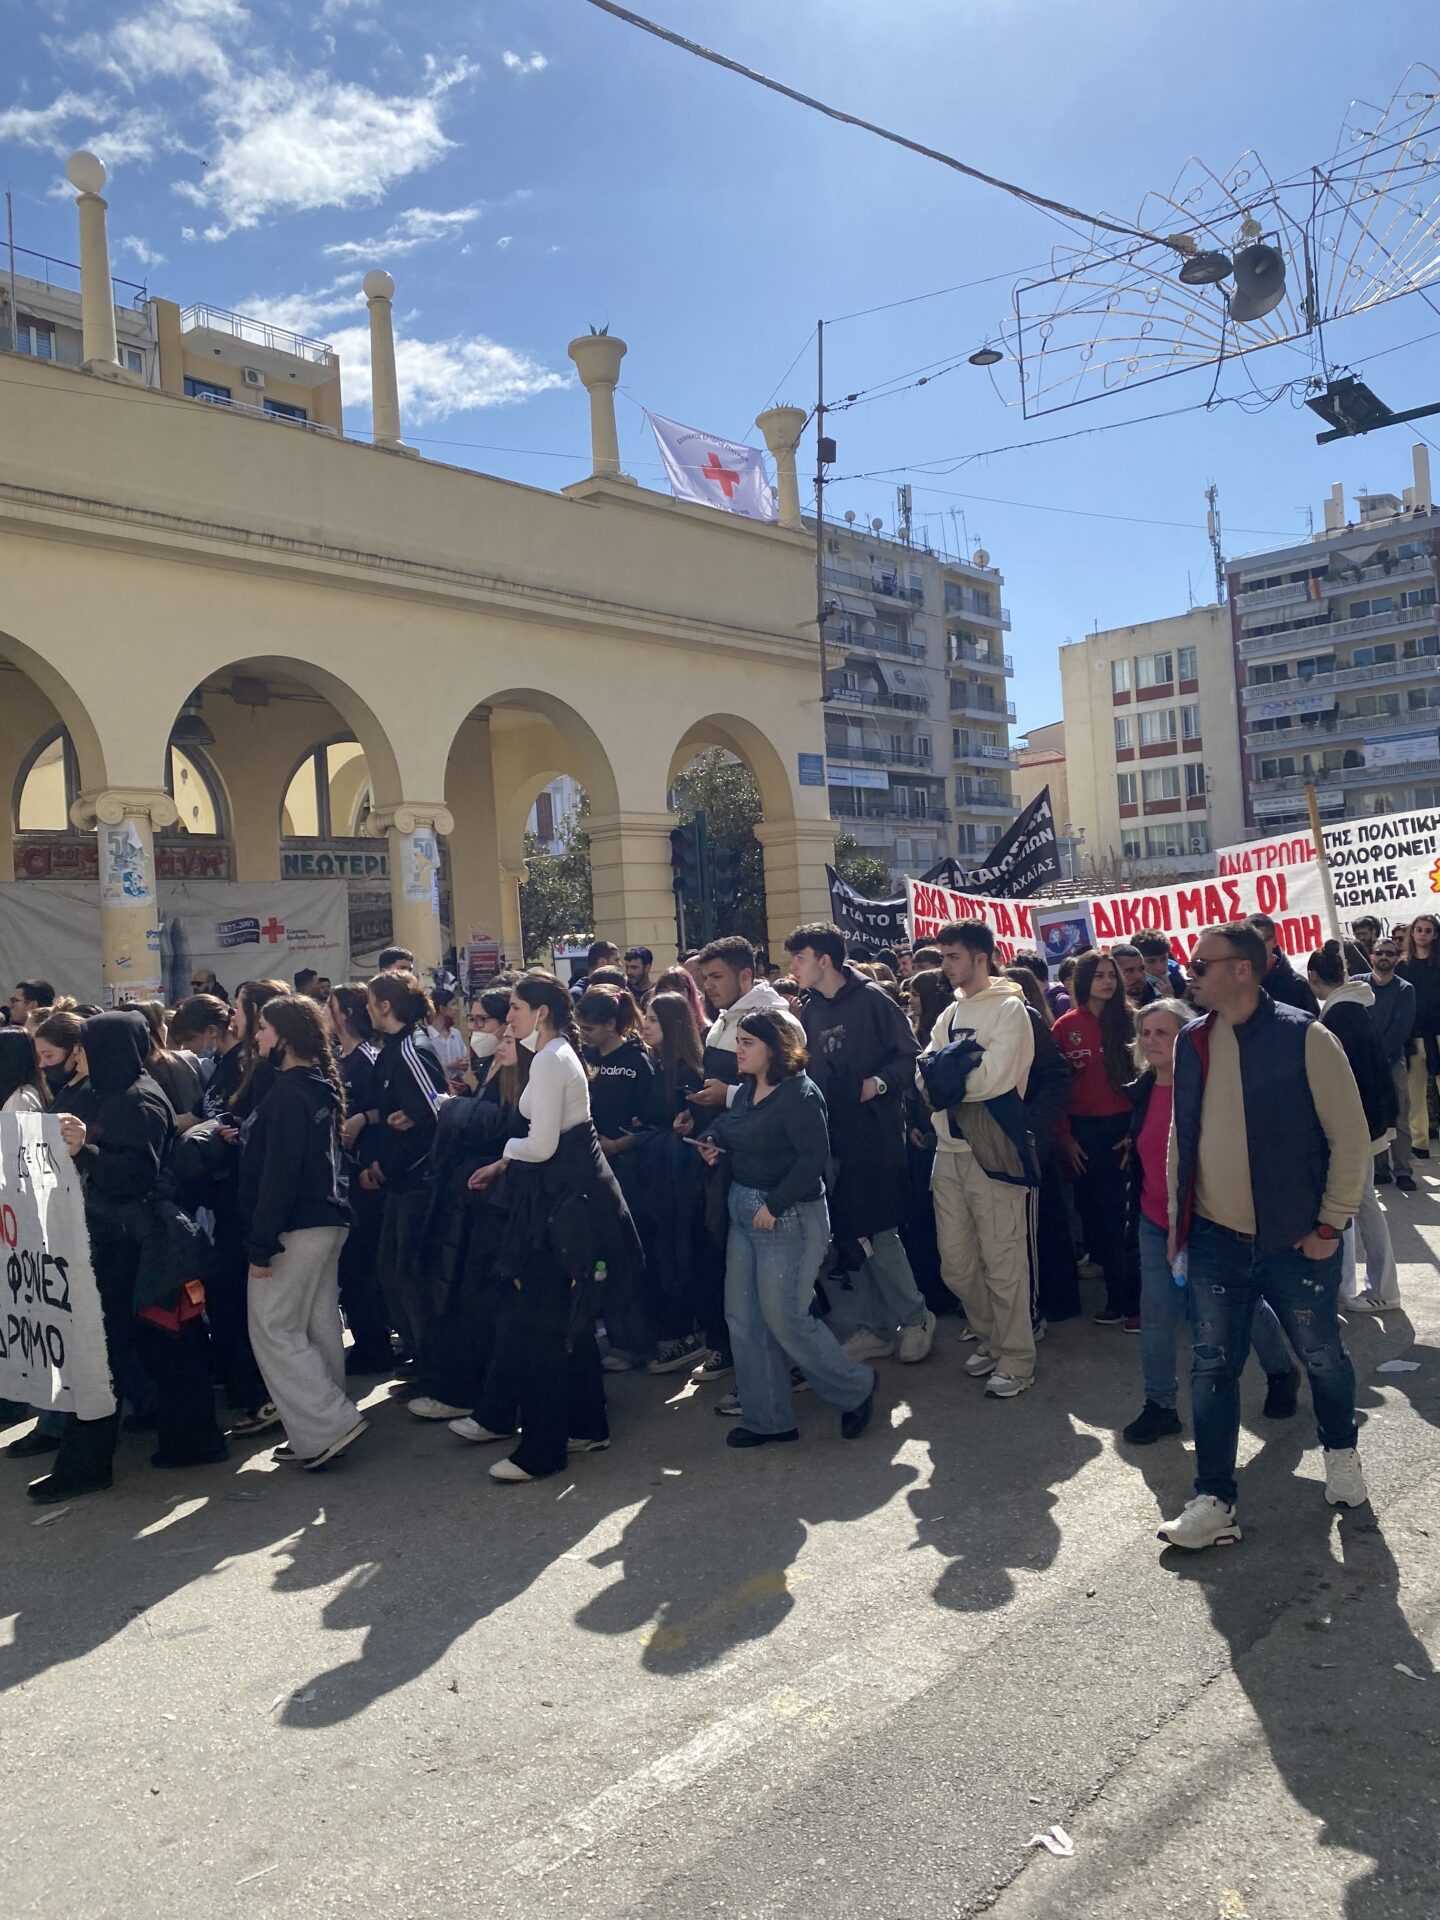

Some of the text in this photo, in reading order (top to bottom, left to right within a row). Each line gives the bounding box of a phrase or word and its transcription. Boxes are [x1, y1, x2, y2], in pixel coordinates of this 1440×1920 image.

[1322, 828, 1353, 849] ΤΗΣ
[284, 854, 387, 876] ΝΕΩΤΕΡΙ
[1373, 864, 1399, 883] ΜΕ
[913, 883, 952, 921] ΔΙΚΑ
[988, 902, 1015, 938] ΤΑ
[1092, 894, 1173, 938] ΔΙΚΟΙ
[1176, 880, 1248, 928] ΜΑΣ
[1256, 872, 1290, 915] ΟΙ
[866, 913, 890, 927] ΤΟ
